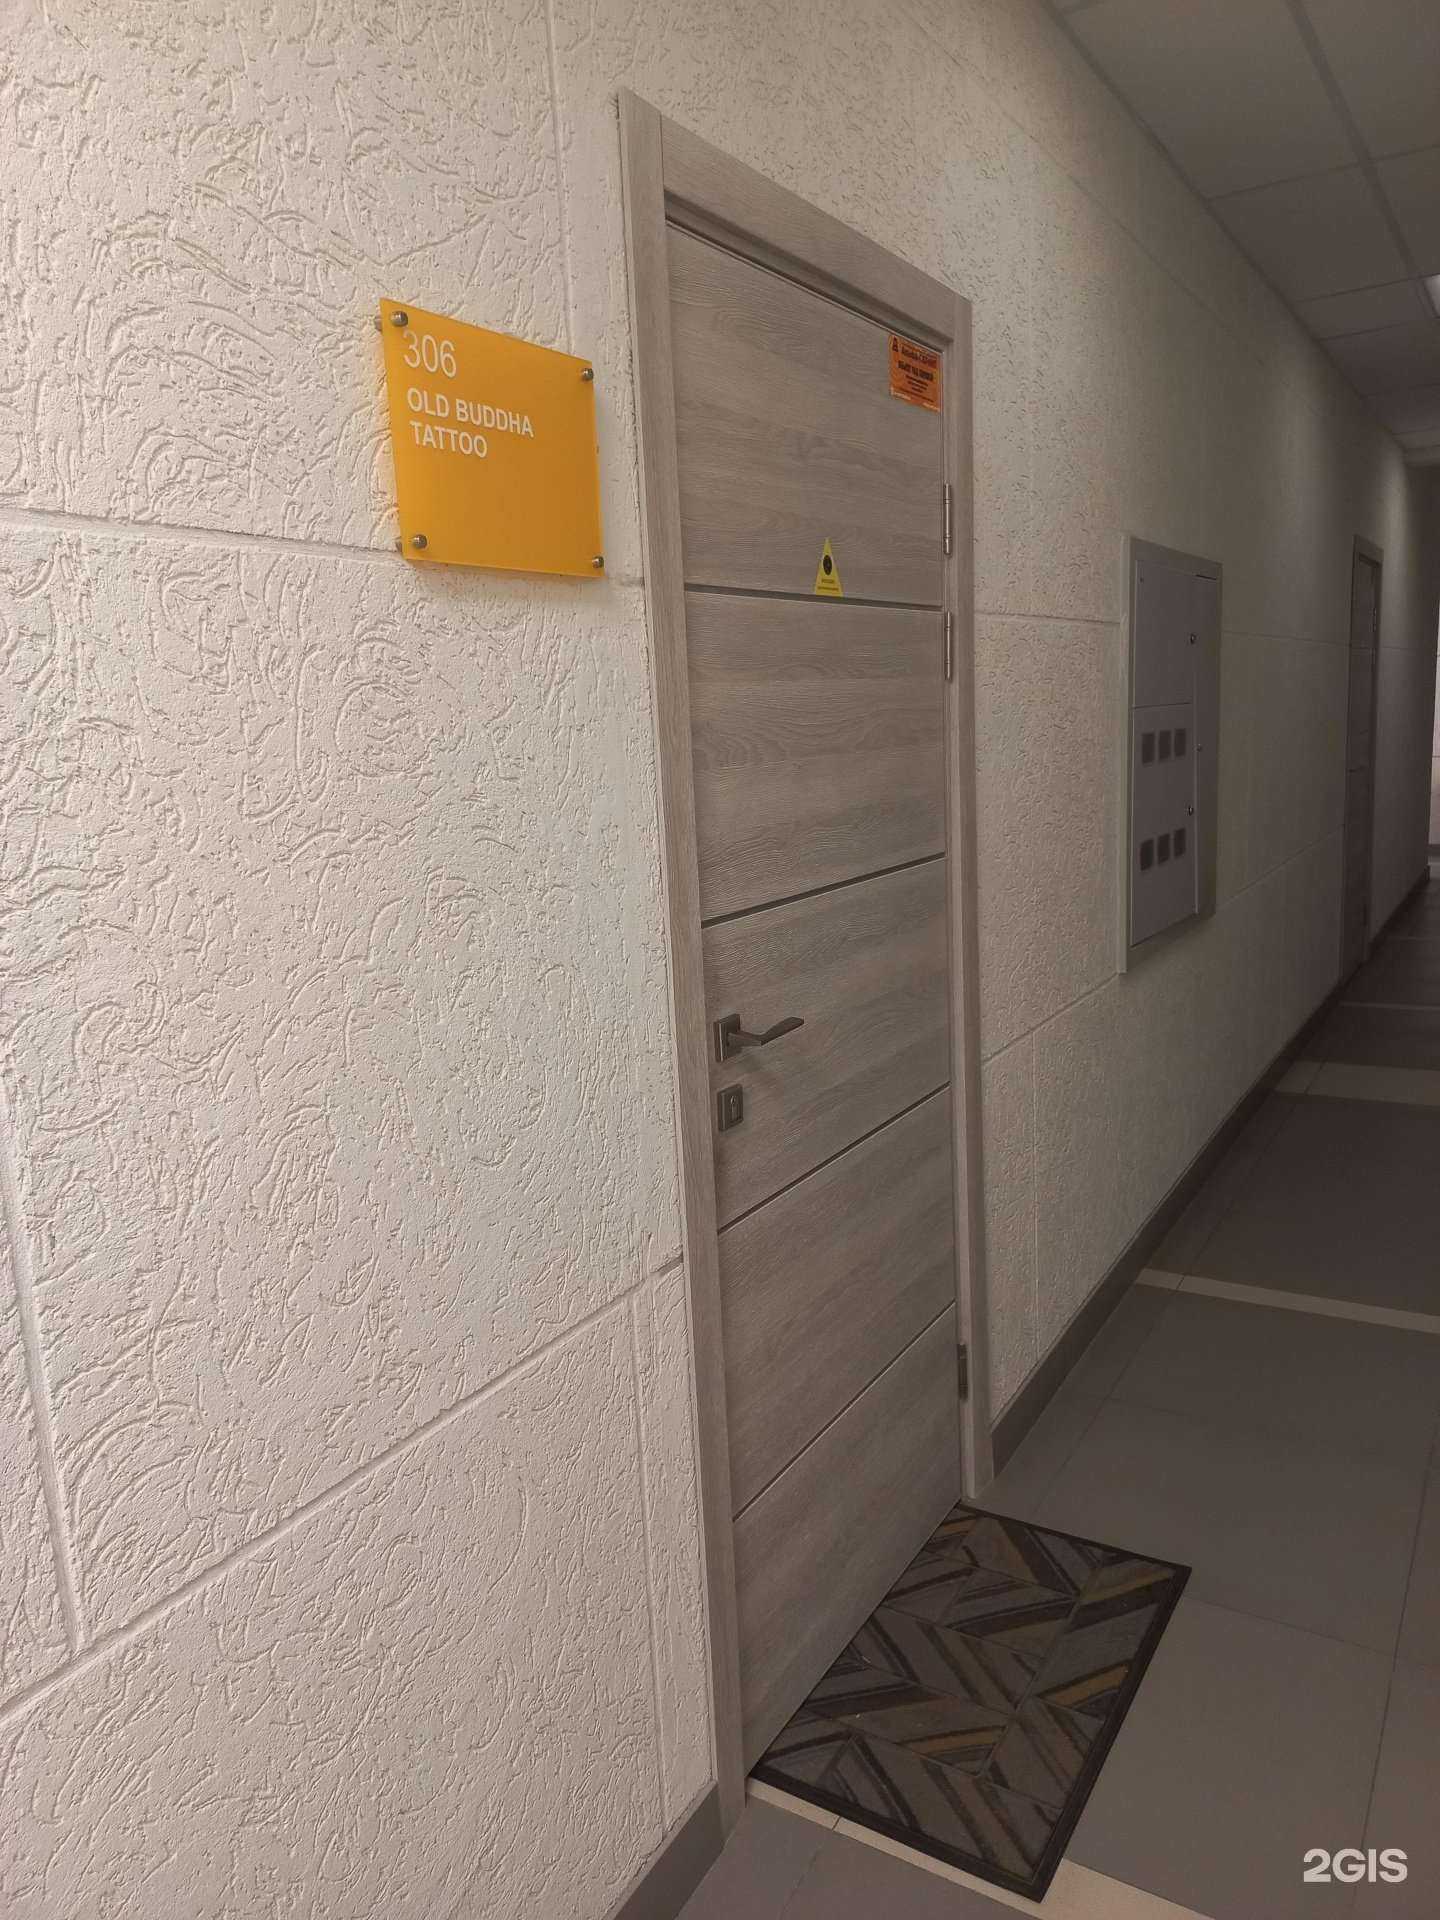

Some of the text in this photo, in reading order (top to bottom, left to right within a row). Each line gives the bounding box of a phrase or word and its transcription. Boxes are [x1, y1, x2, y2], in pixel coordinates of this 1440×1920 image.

[404, 329, 457, 378] 306
[408, 388, 534, 438] OLD BUDDHA
[410, 421, 487, 458] TATTOO
